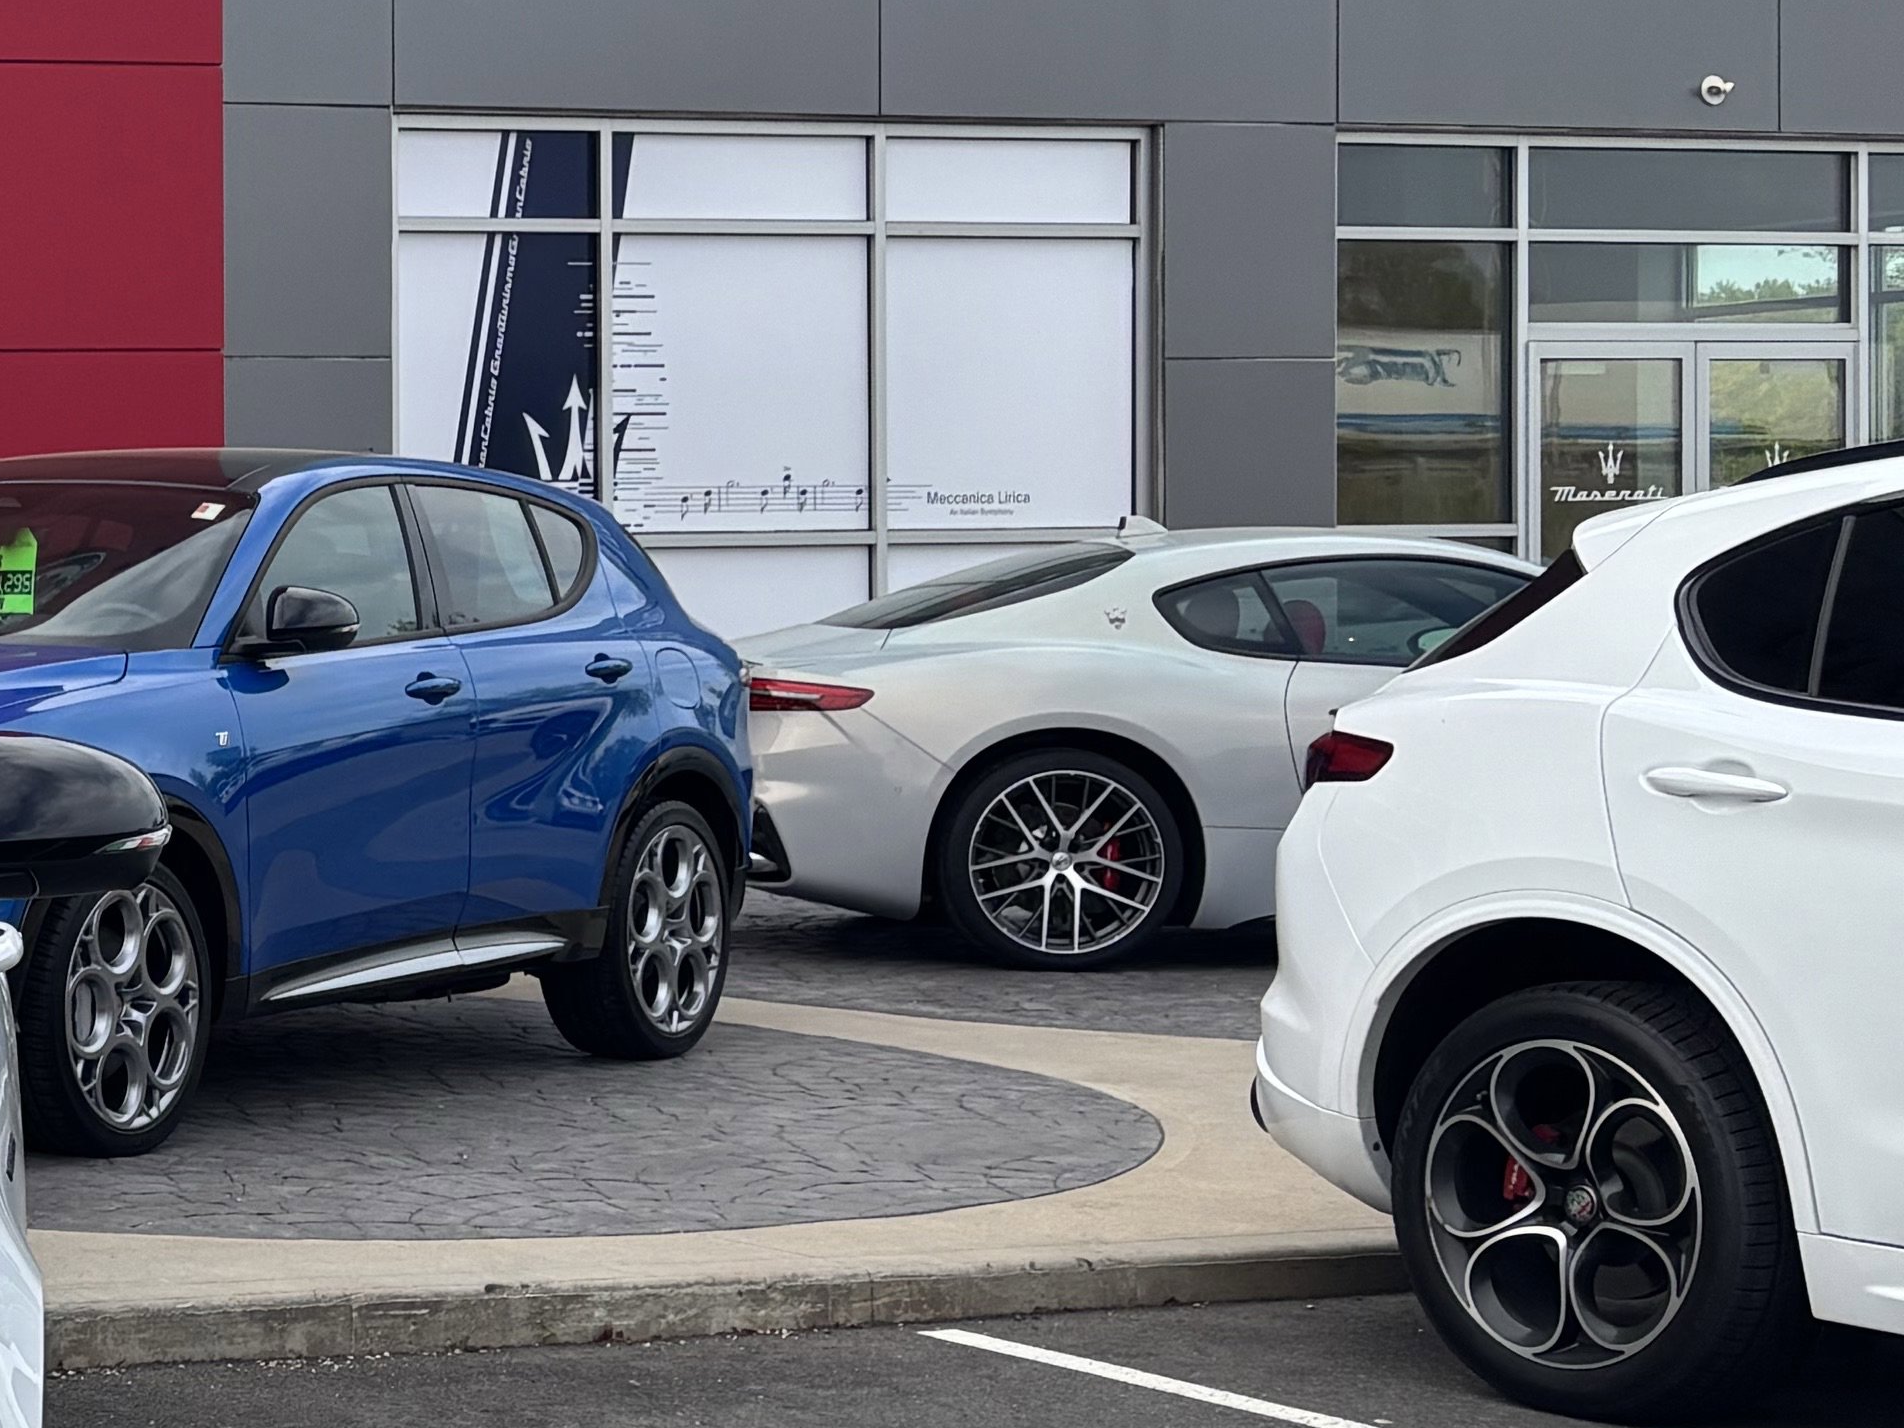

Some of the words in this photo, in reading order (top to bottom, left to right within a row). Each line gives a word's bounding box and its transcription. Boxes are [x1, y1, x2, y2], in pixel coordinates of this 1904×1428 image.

[926, 490, 995, 505] Meccanica
[998, 490, 1031, 505] Lirica
[1549, 483, 1670, 503] Maserati
